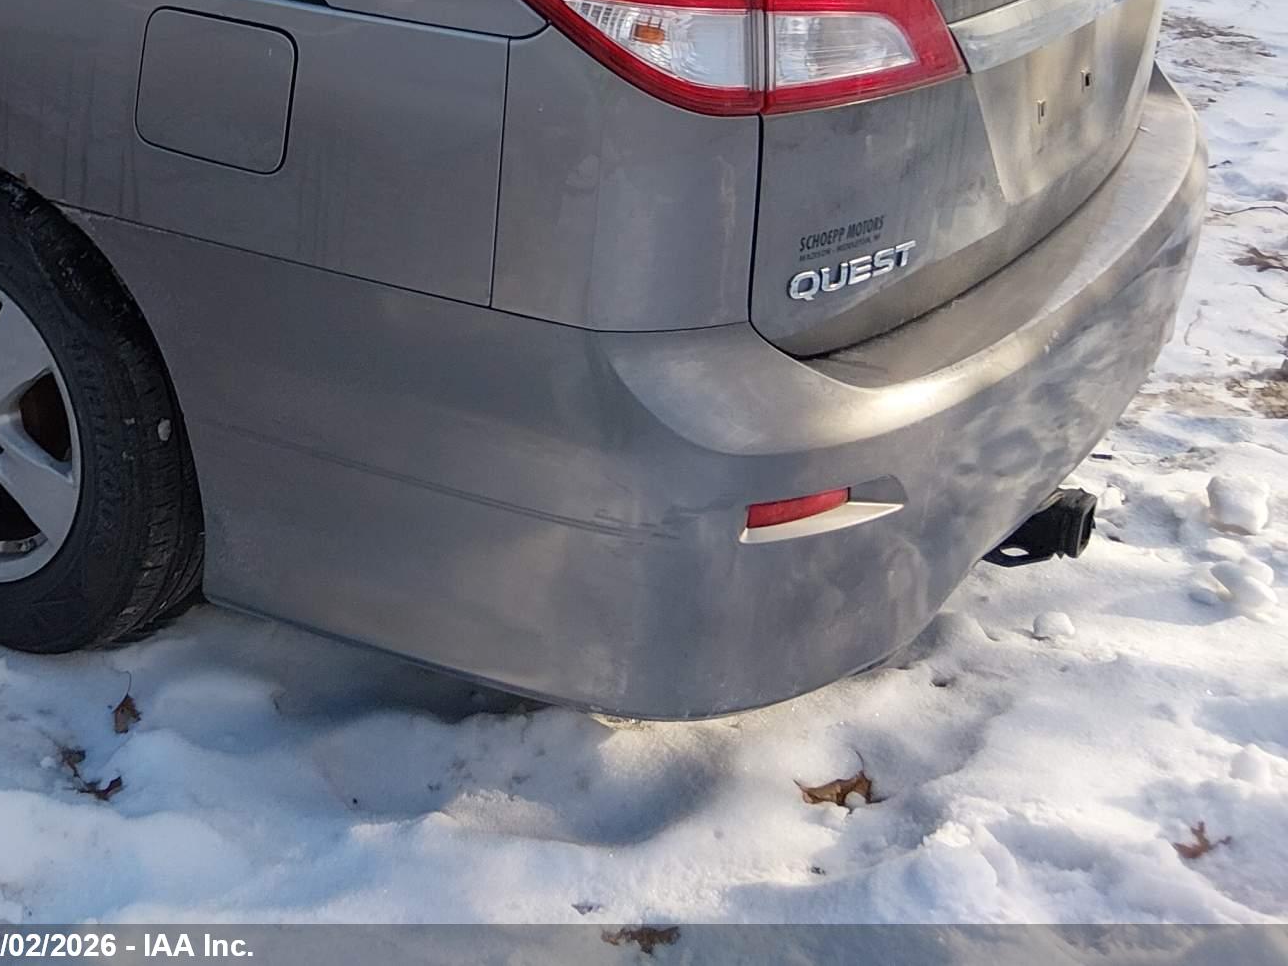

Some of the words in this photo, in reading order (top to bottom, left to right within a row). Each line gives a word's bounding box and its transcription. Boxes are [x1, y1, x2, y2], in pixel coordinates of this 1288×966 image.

[798, 226, 846, 253] SCHOEPP
[845, 214, 885, 240] MOTORS
[788, 239, 917, 302] QUEST
